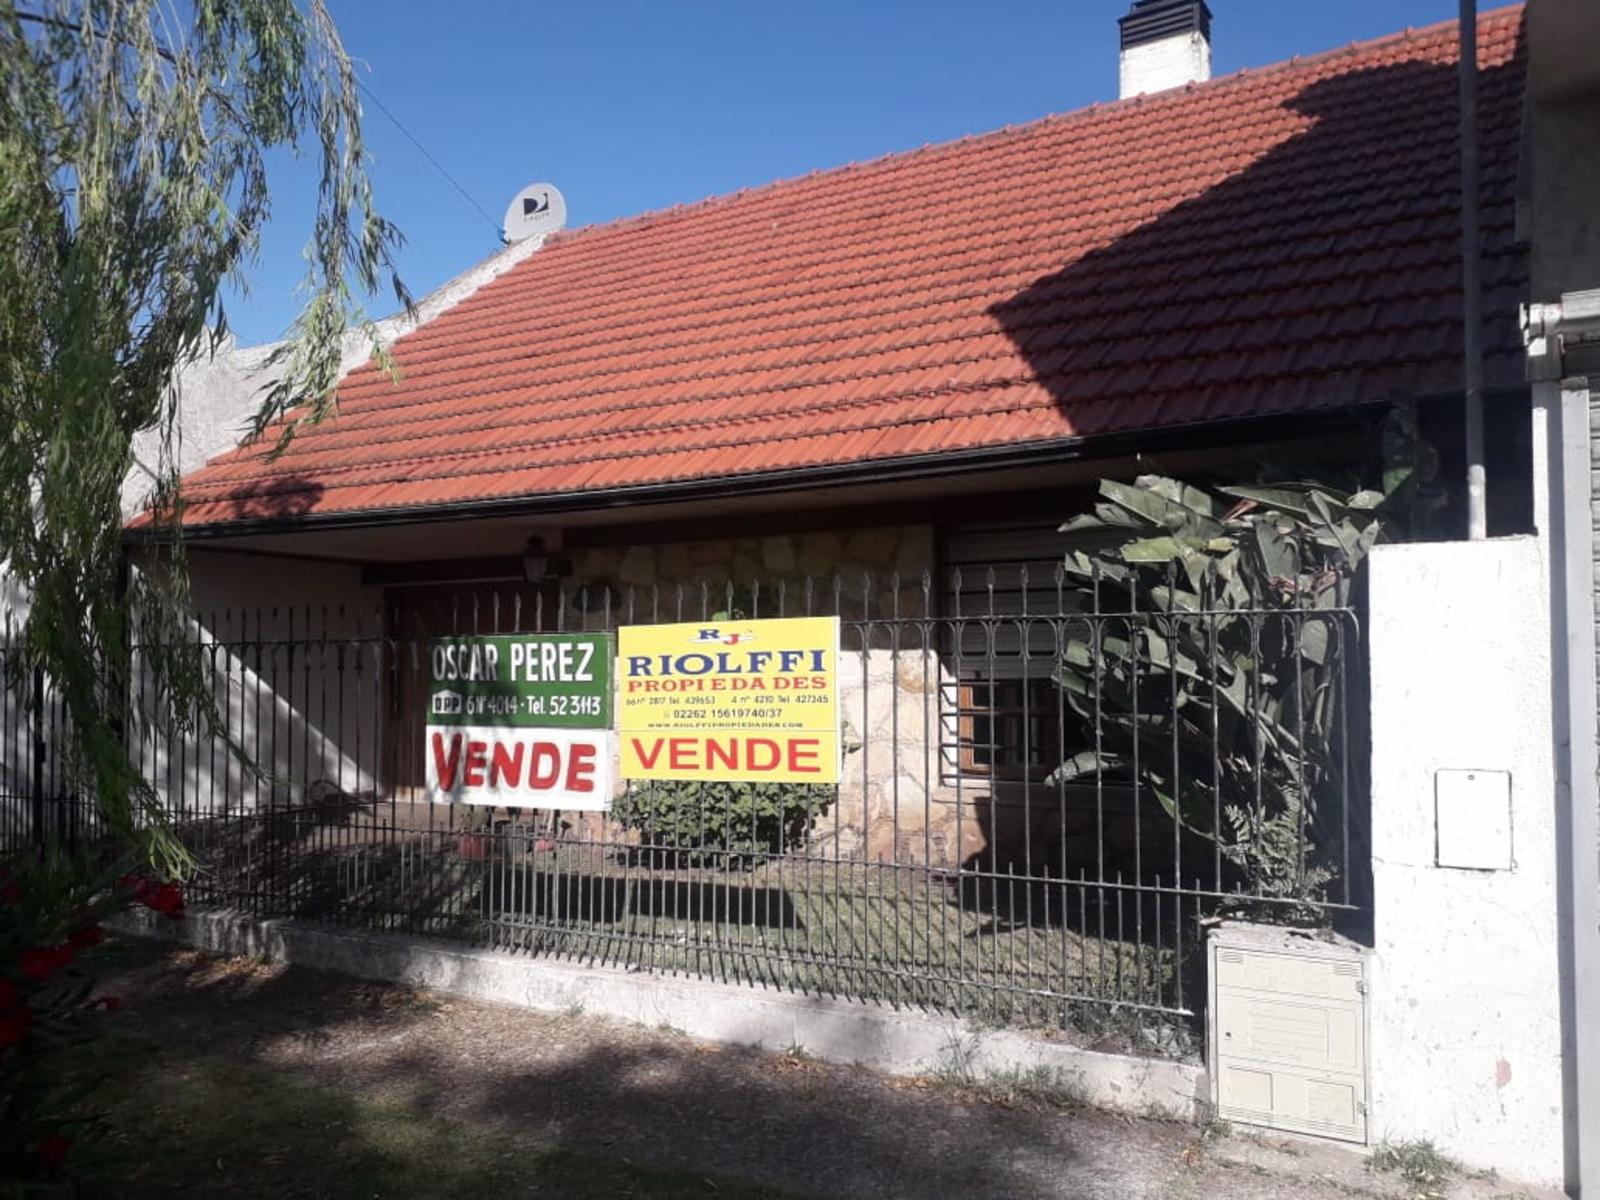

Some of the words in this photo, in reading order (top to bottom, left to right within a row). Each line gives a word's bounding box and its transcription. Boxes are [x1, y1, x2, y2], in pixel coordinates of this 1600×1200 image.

[432, 643, 499, 682] OSCAR
[510, 641, 595, 682] PEREZ
[627, 650, 827, 677] RIOLFFI
[628, 676, 827, 693] PROPIEDADES
[673, 709, 707, 719] 02262
[711, 707, 783, 719] 15619740/37
[432, 731, 597, 793] VENDE
[631, 737, 822, 773] VENDE
